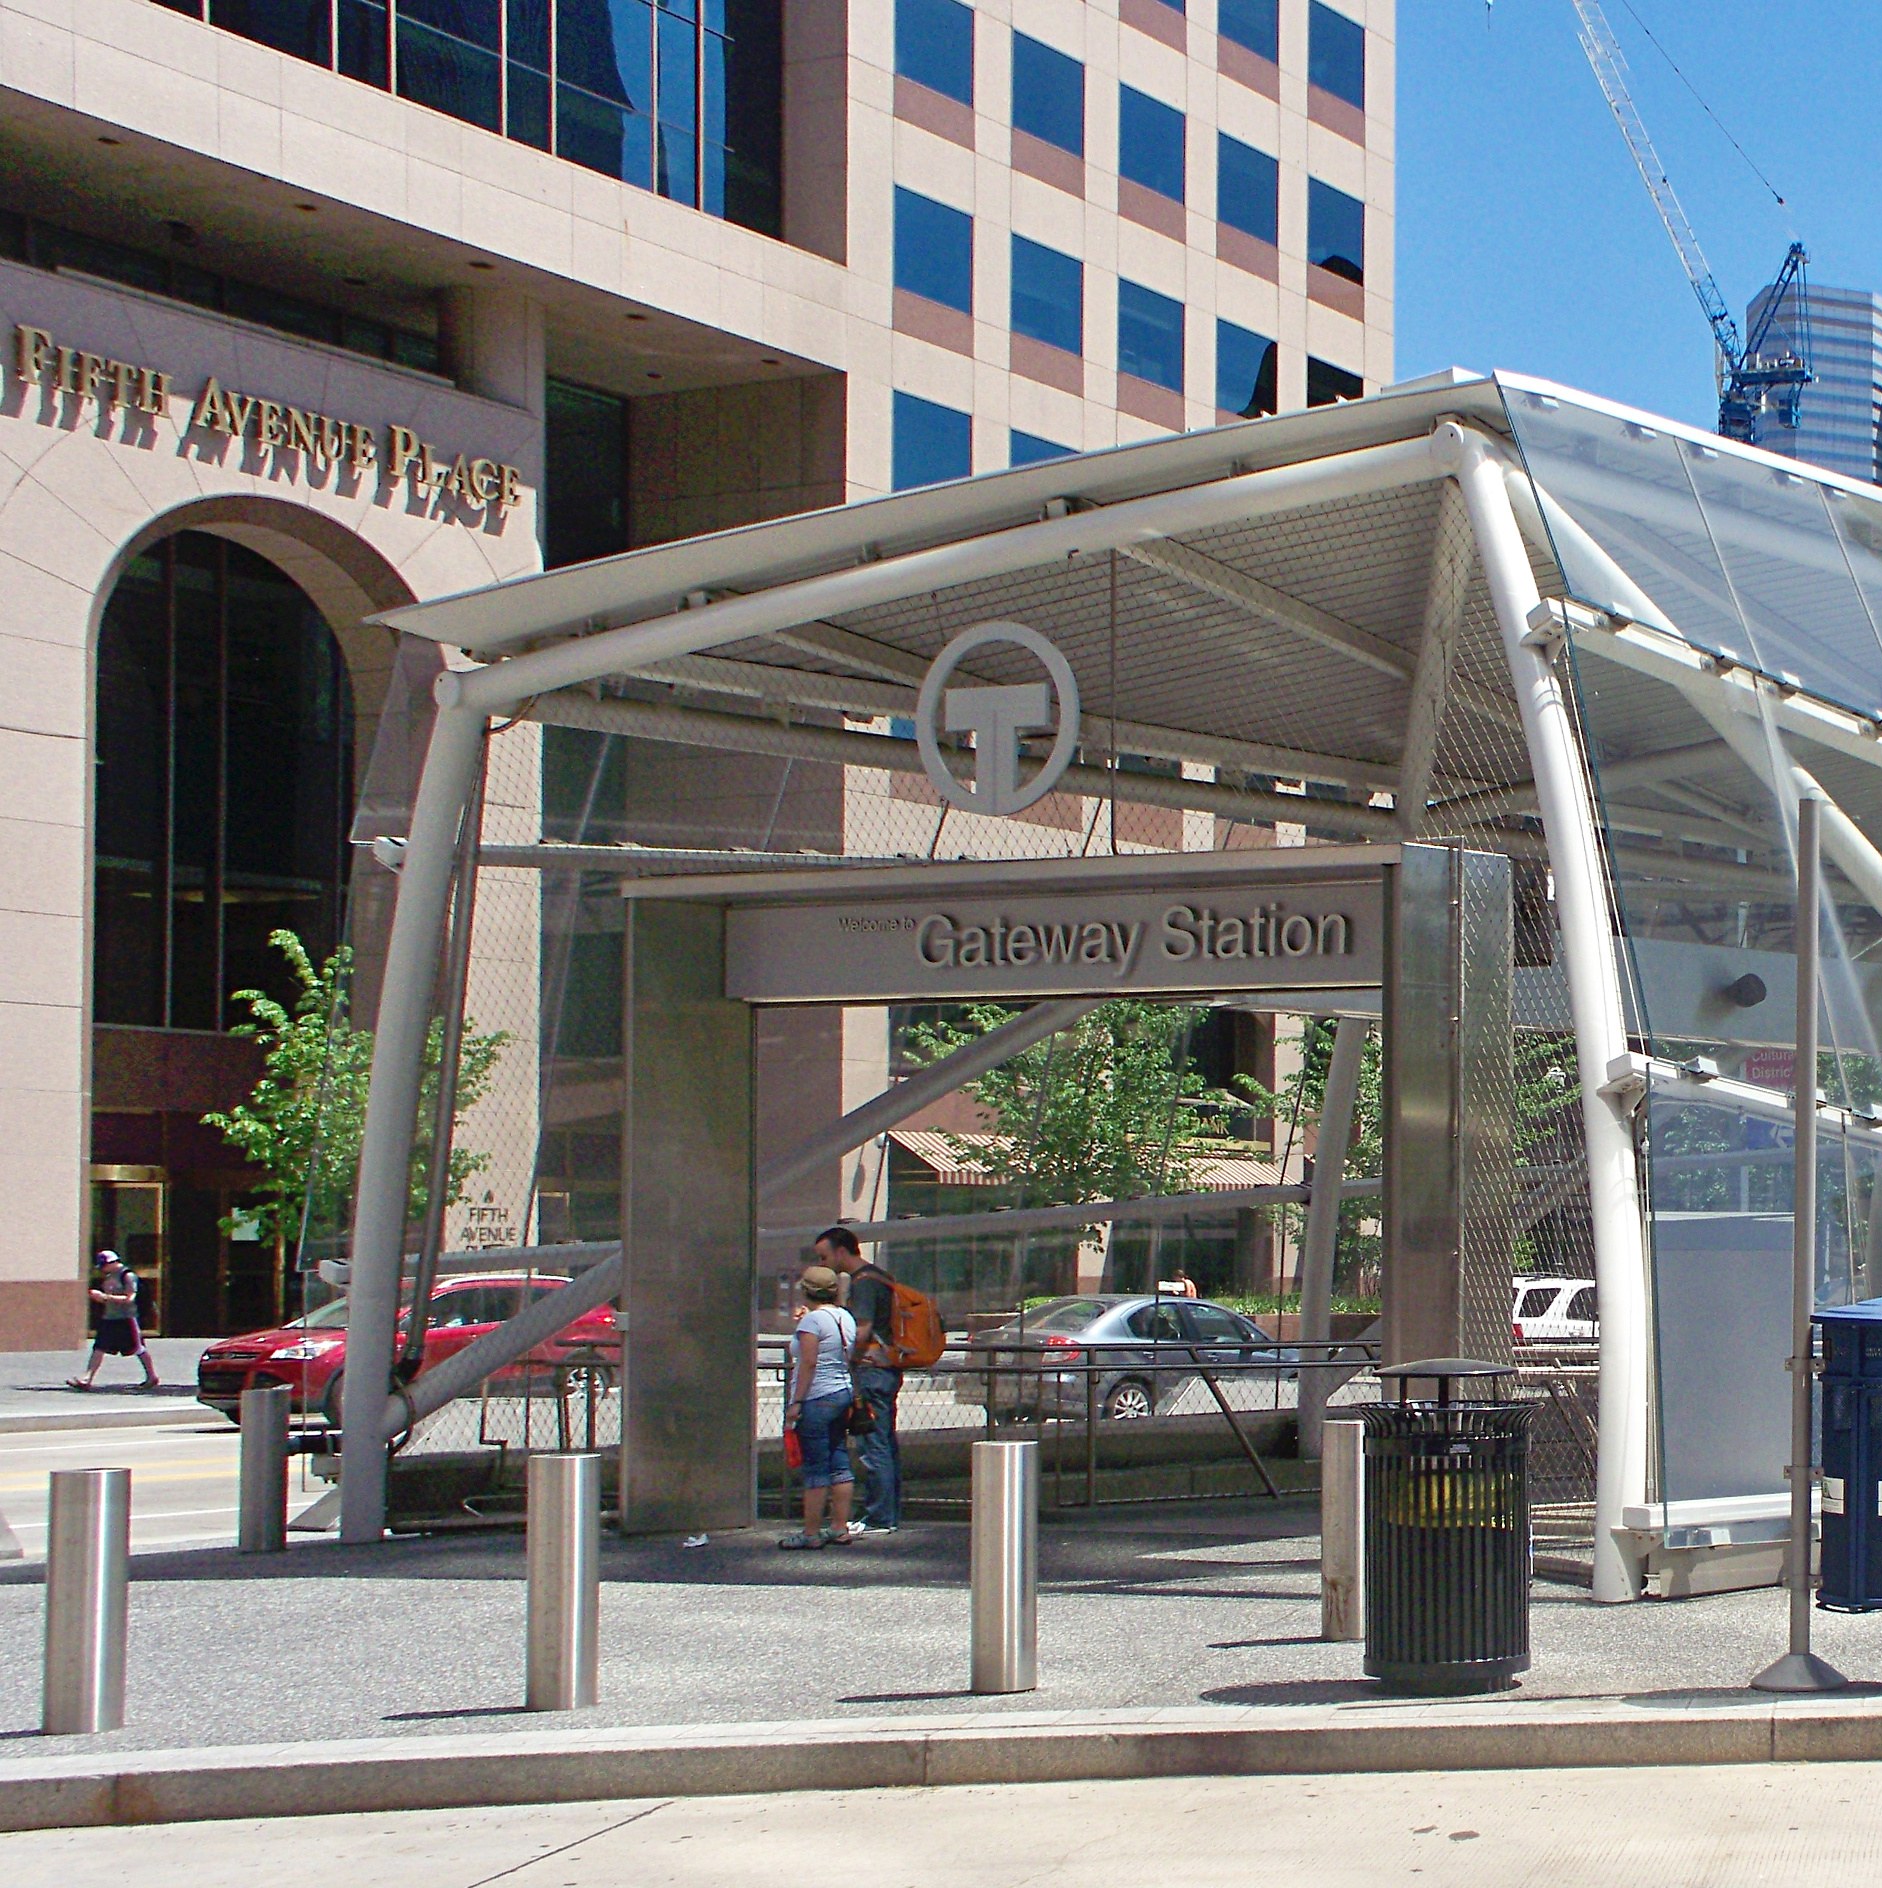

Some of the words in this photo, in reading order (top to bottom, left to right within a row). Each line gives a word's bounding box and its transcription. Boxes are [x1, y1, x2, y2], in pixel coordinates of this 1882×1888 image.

[16, 324, 173, 419] FIFTH
[192, 376, 376, 470] AVENUE
[388, 424, 522, 508] PLACE
[838, 917, 898, 933] Welcome
[902, 916, 915, 931] to
[917, 914, 1143, 978] Gateway
[1161, 903, 1348, 962] Station
[1752, 1049, 1794, 1061] Cultura
[1752, 1066, 1793, 1079] Distric
[469, 1207, 509, 1223] FIFTH
[461, 1226, 518, 1242] AVENUE
